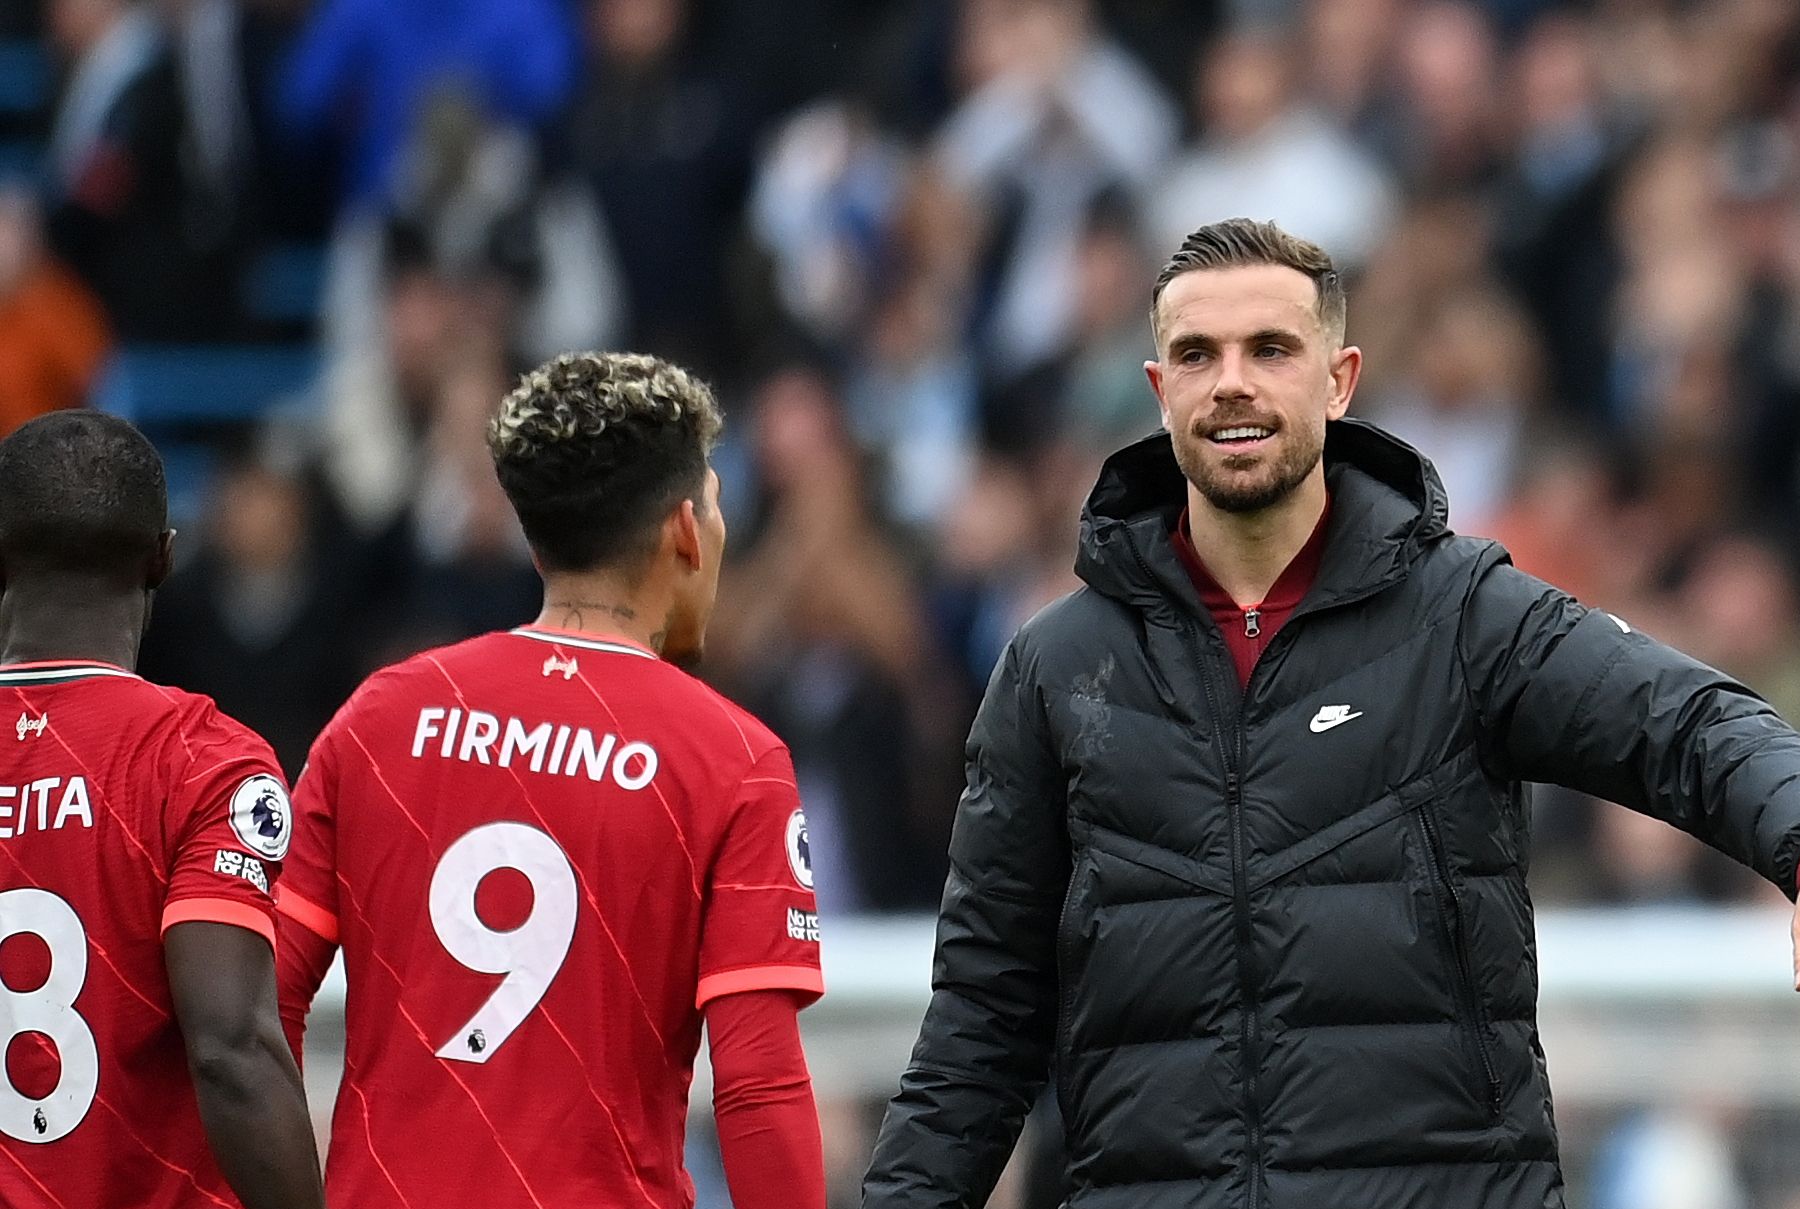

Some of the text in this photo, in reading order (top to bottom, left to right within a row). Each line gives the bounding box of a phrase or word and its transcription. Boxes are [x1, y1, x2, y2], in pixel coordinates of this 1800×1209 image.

[411, 706, 659, 791] FIRMINO
[0, 887, 99, 1144] 8
[428, 821, 578, 1064] 9
